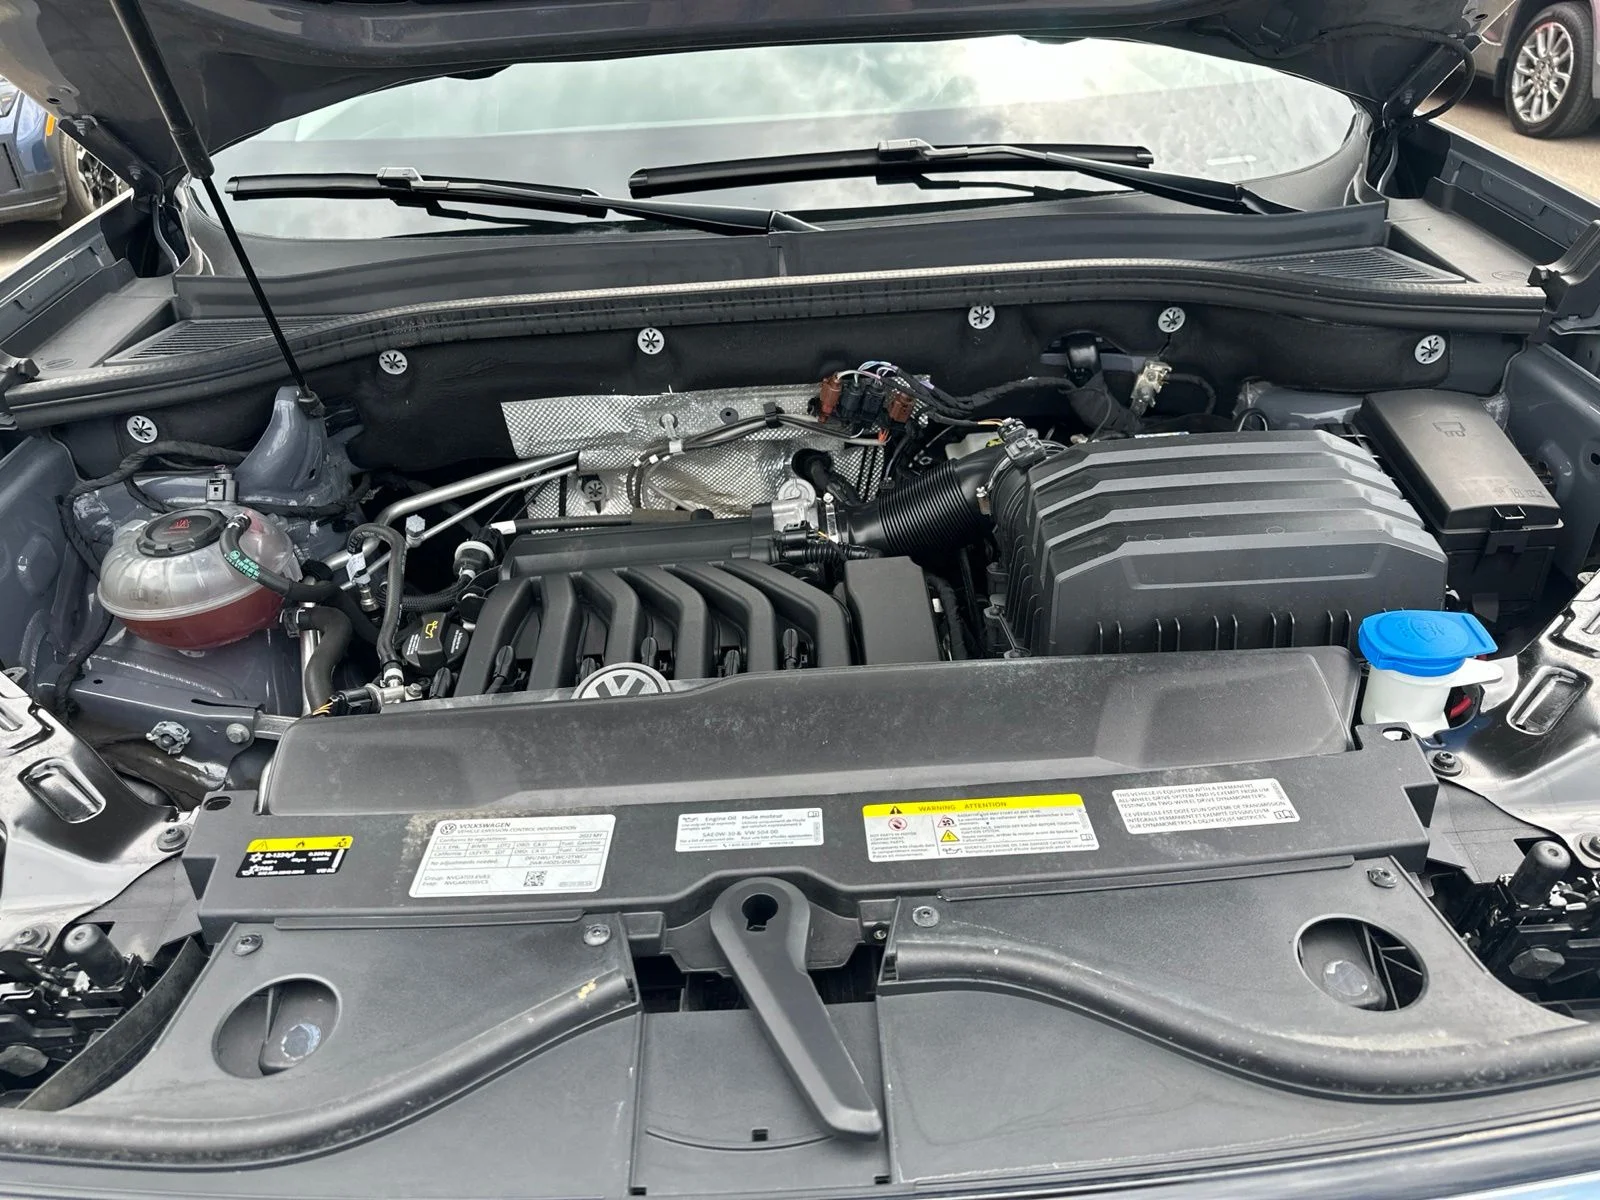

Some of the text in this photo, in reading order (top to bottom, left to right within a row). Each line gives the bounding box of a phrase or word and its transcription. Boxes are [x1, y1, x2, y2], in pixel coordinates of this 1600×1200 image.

[1217, 782, 1252, 790] PERMANENT
[964, 801, 1007, 809] ATTENTION
[1158, 798, 1194, 806] TWO-WHEEL
[1242, 800, 1284, 808] TRANSMISSION
[1158, 813, 1192, 821] PERMANENT
